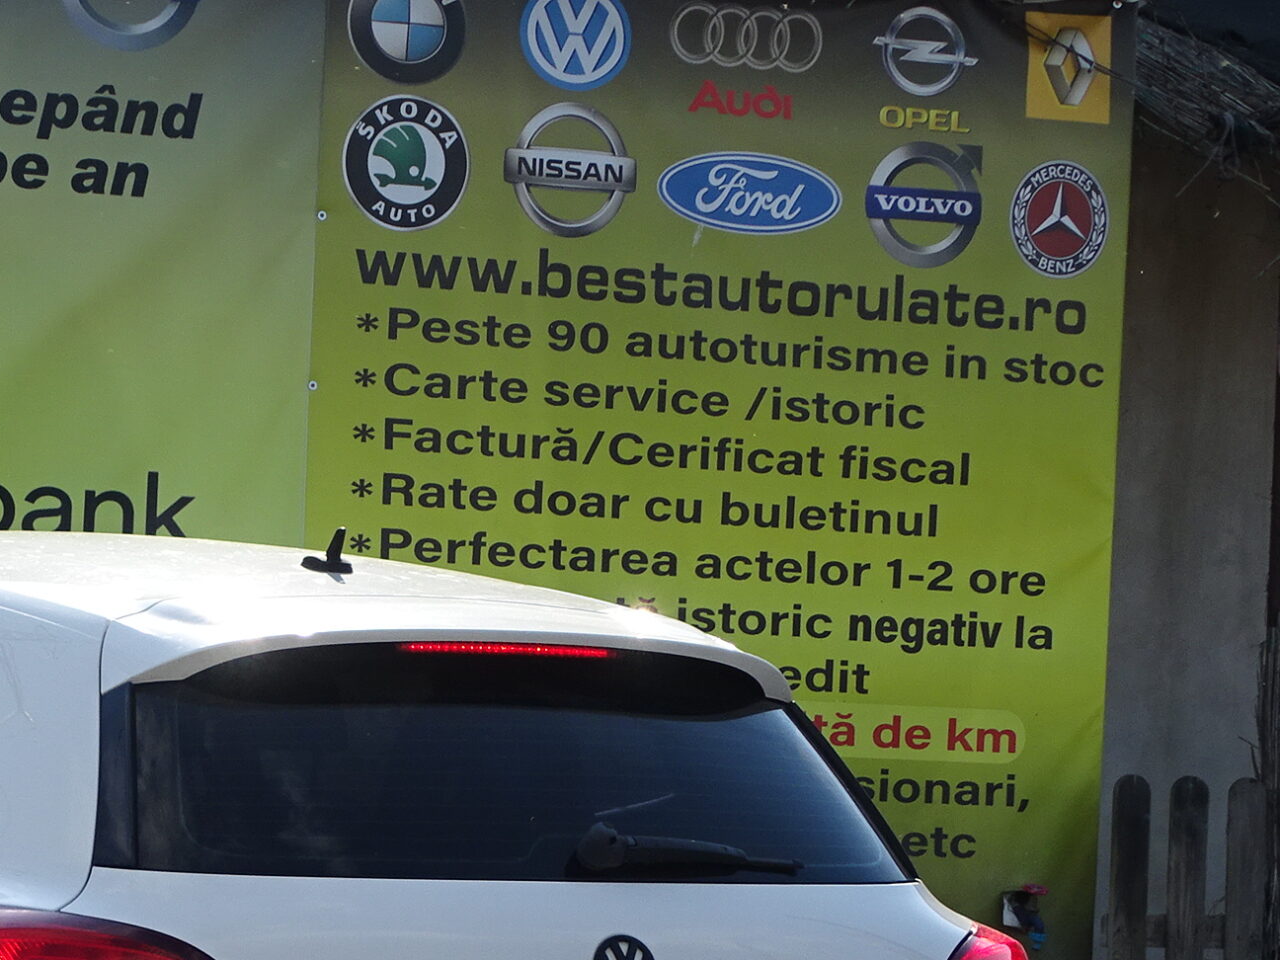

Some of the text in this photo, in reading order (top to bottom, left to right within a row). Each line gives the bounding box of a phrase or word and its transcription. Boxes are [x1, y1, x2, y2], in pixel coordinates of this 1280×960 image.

[688, 80, 793, 120] Audi
[879, 105, 970, 133] OPEL
[70, 157, 150, 198] an
[517, 156, 623, 184] NISSAN
[1031, 165, 1094, 193] MERCEDES
[371, 201, 436, 222] AUTO
[695, 163, 805, 221] Ford
[875, 194, 973, 216] VOLVO
[1038, 258, 1077, 274] BENZ
[355, 248, 1087, 334] www.bestautorulate.ro
[547, 319, 609, 355] 90
[625, 328, 929, 376] autoturisme
[945, 344, 987, 380] in
[1003, 353, 1105, 387] stoc
[543, 378, 729, 418] service
[744, 386, 925, 430] /istoric
[840, 445, 970, 486] fiscal
[513, 480, 629, 520] doar
[645, 494, 702, 524] cu
[721, 491, 938, 538] buletinul
[694, 551, 871, 587] actelor
[886, 558, 954, 592] 1-2
[969, 569, 1046, 597] ore
[677, 598, 1054, 655] istoric negativ la
[872, 715, 932, 750] de
[946, 718, 1017, 754] km
[900, 827, 977, 859] etc
